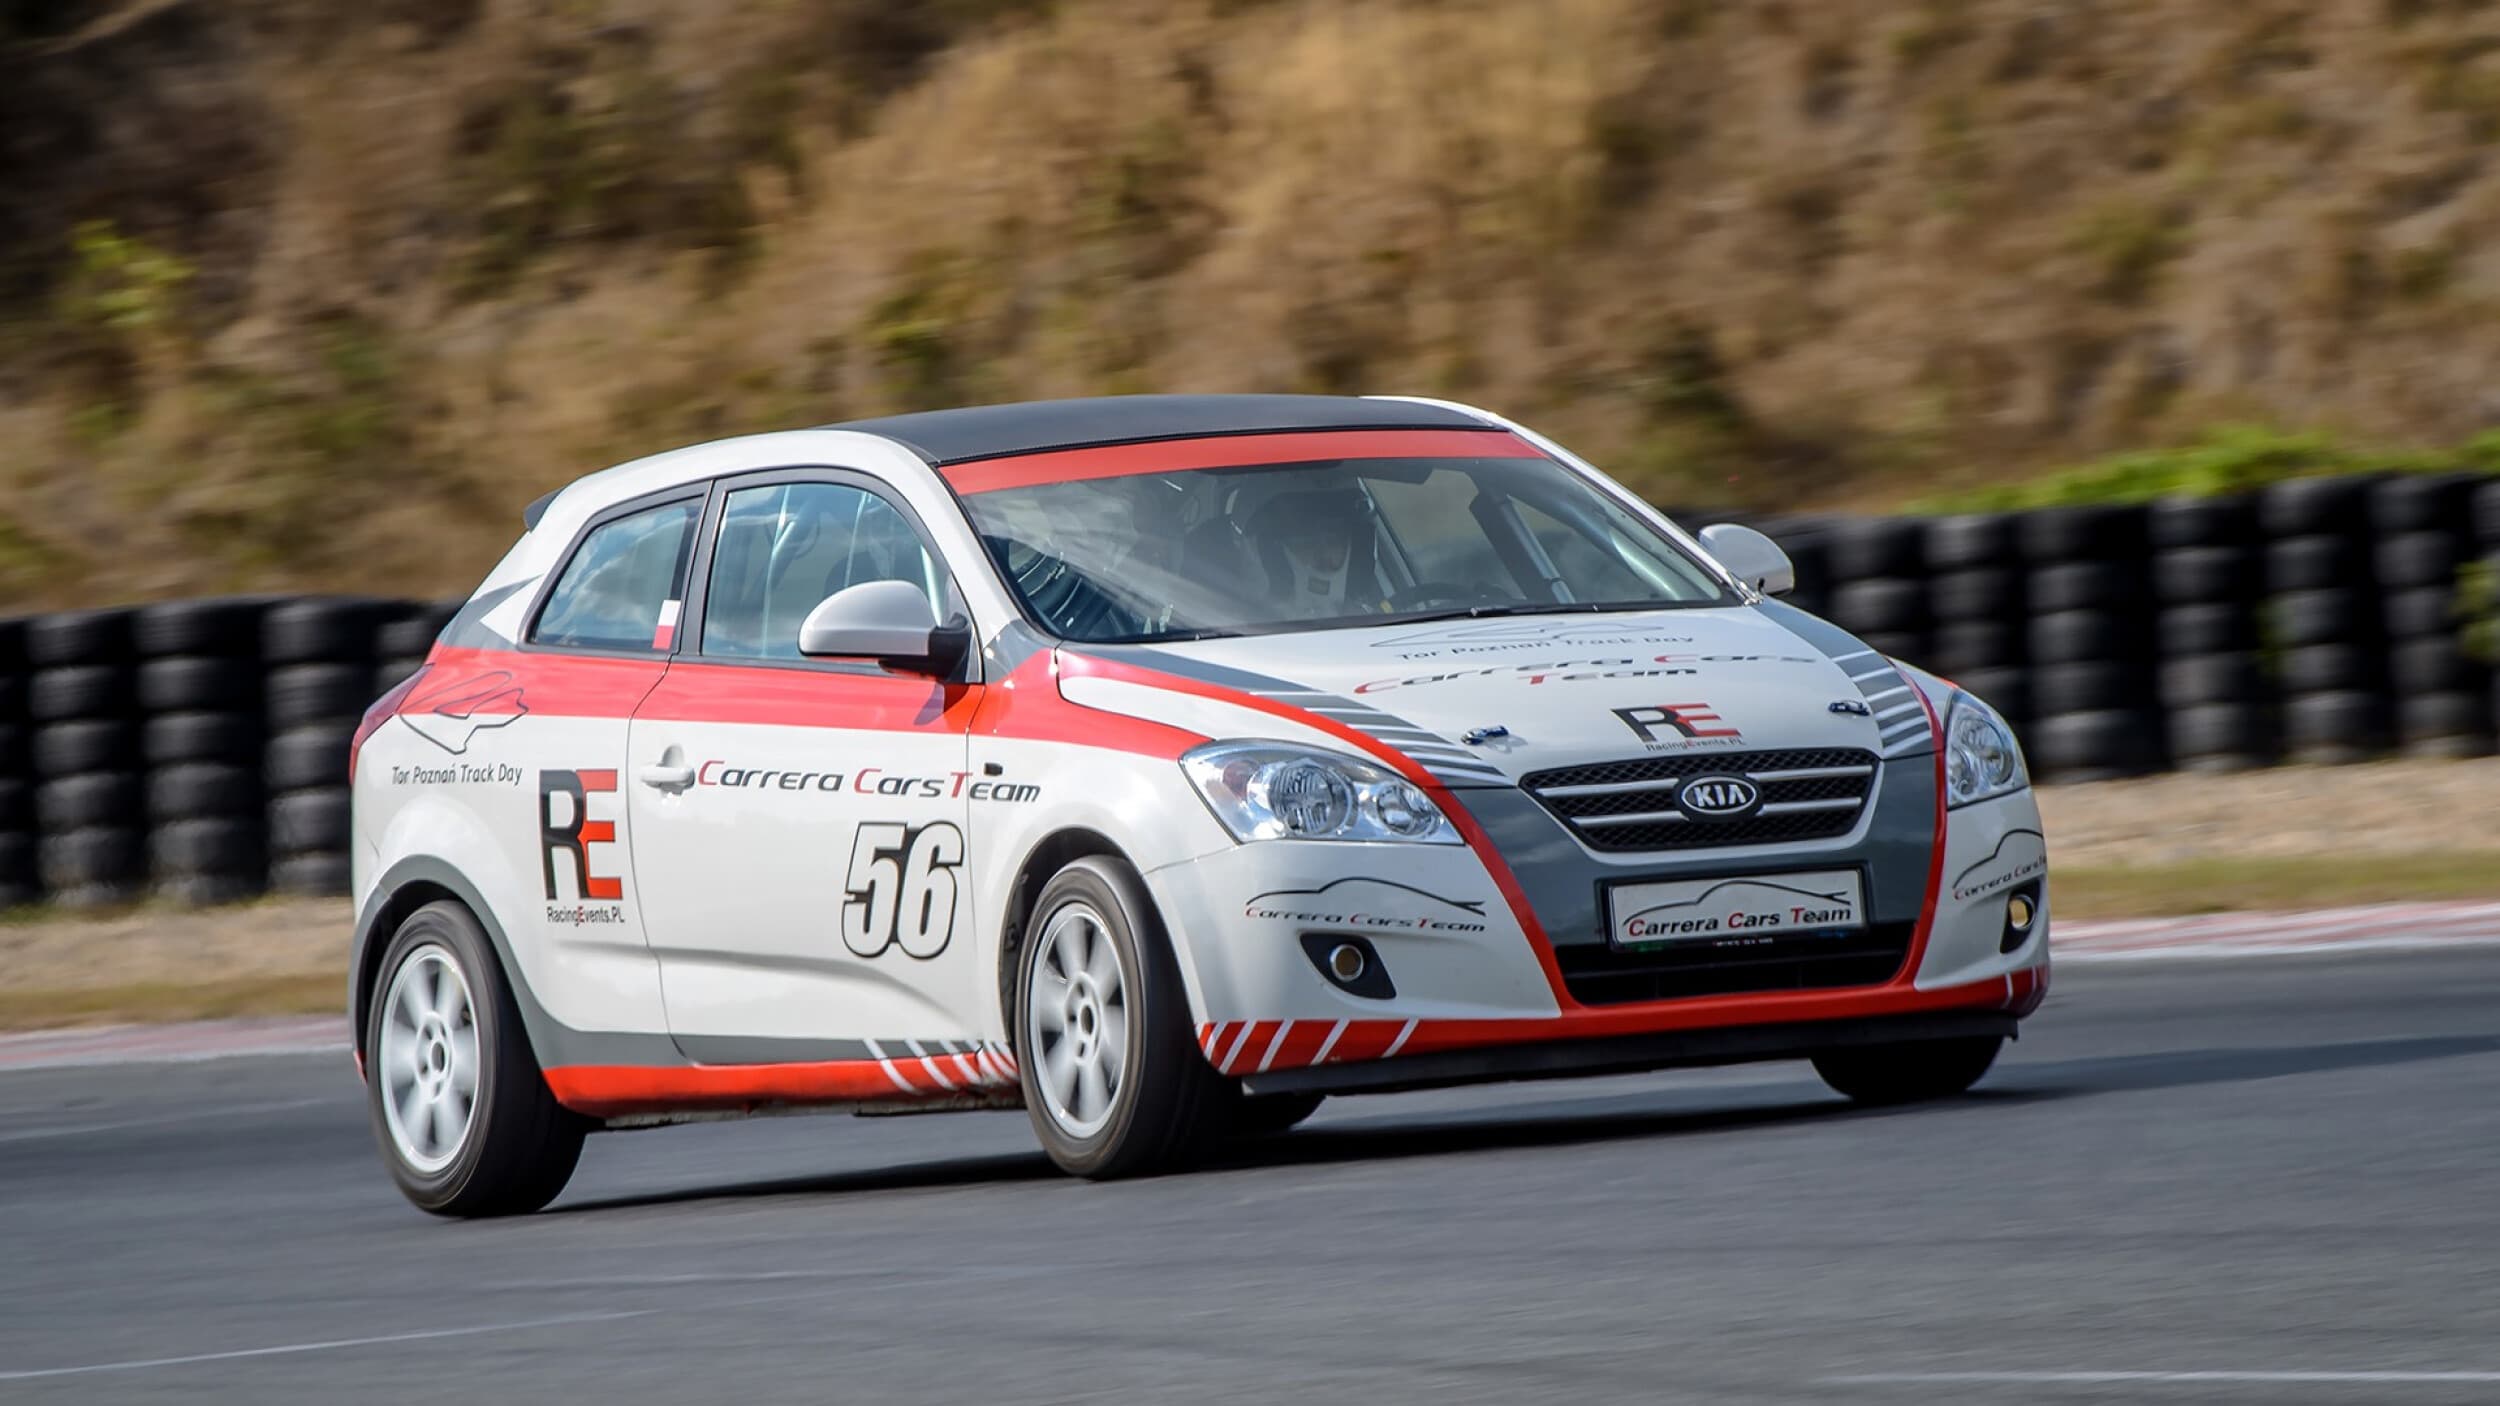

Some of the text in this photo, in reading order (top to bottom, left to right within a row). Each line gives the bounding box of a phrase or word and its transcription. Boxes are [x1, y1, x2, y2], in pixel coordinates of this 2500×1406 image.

[1395, 651, 1441, 661] Tor
[1563, 636, 1636, 646] Track
[1644, 636, 1694, 644] Day
[1353, 654, 1817, 694] Carrera Cars
[1516, 668, 1698, 685] Team
[1610, 702, 1742, 742] RE
[392, 762, 523, 786] Tor Poznań Track Day
[698, 759, 844, 792] Carrera
[1693, 784, 1748, 808] KIA
[538, 768, 624, 901] RE
[841, 819, 966, 961] 56
[546, 905, 626, 928] RacingEvents.PL
[1245, 906, 1342, 924] Carrera
[1628, 906, 1852, 938] Carrera Cars Team
